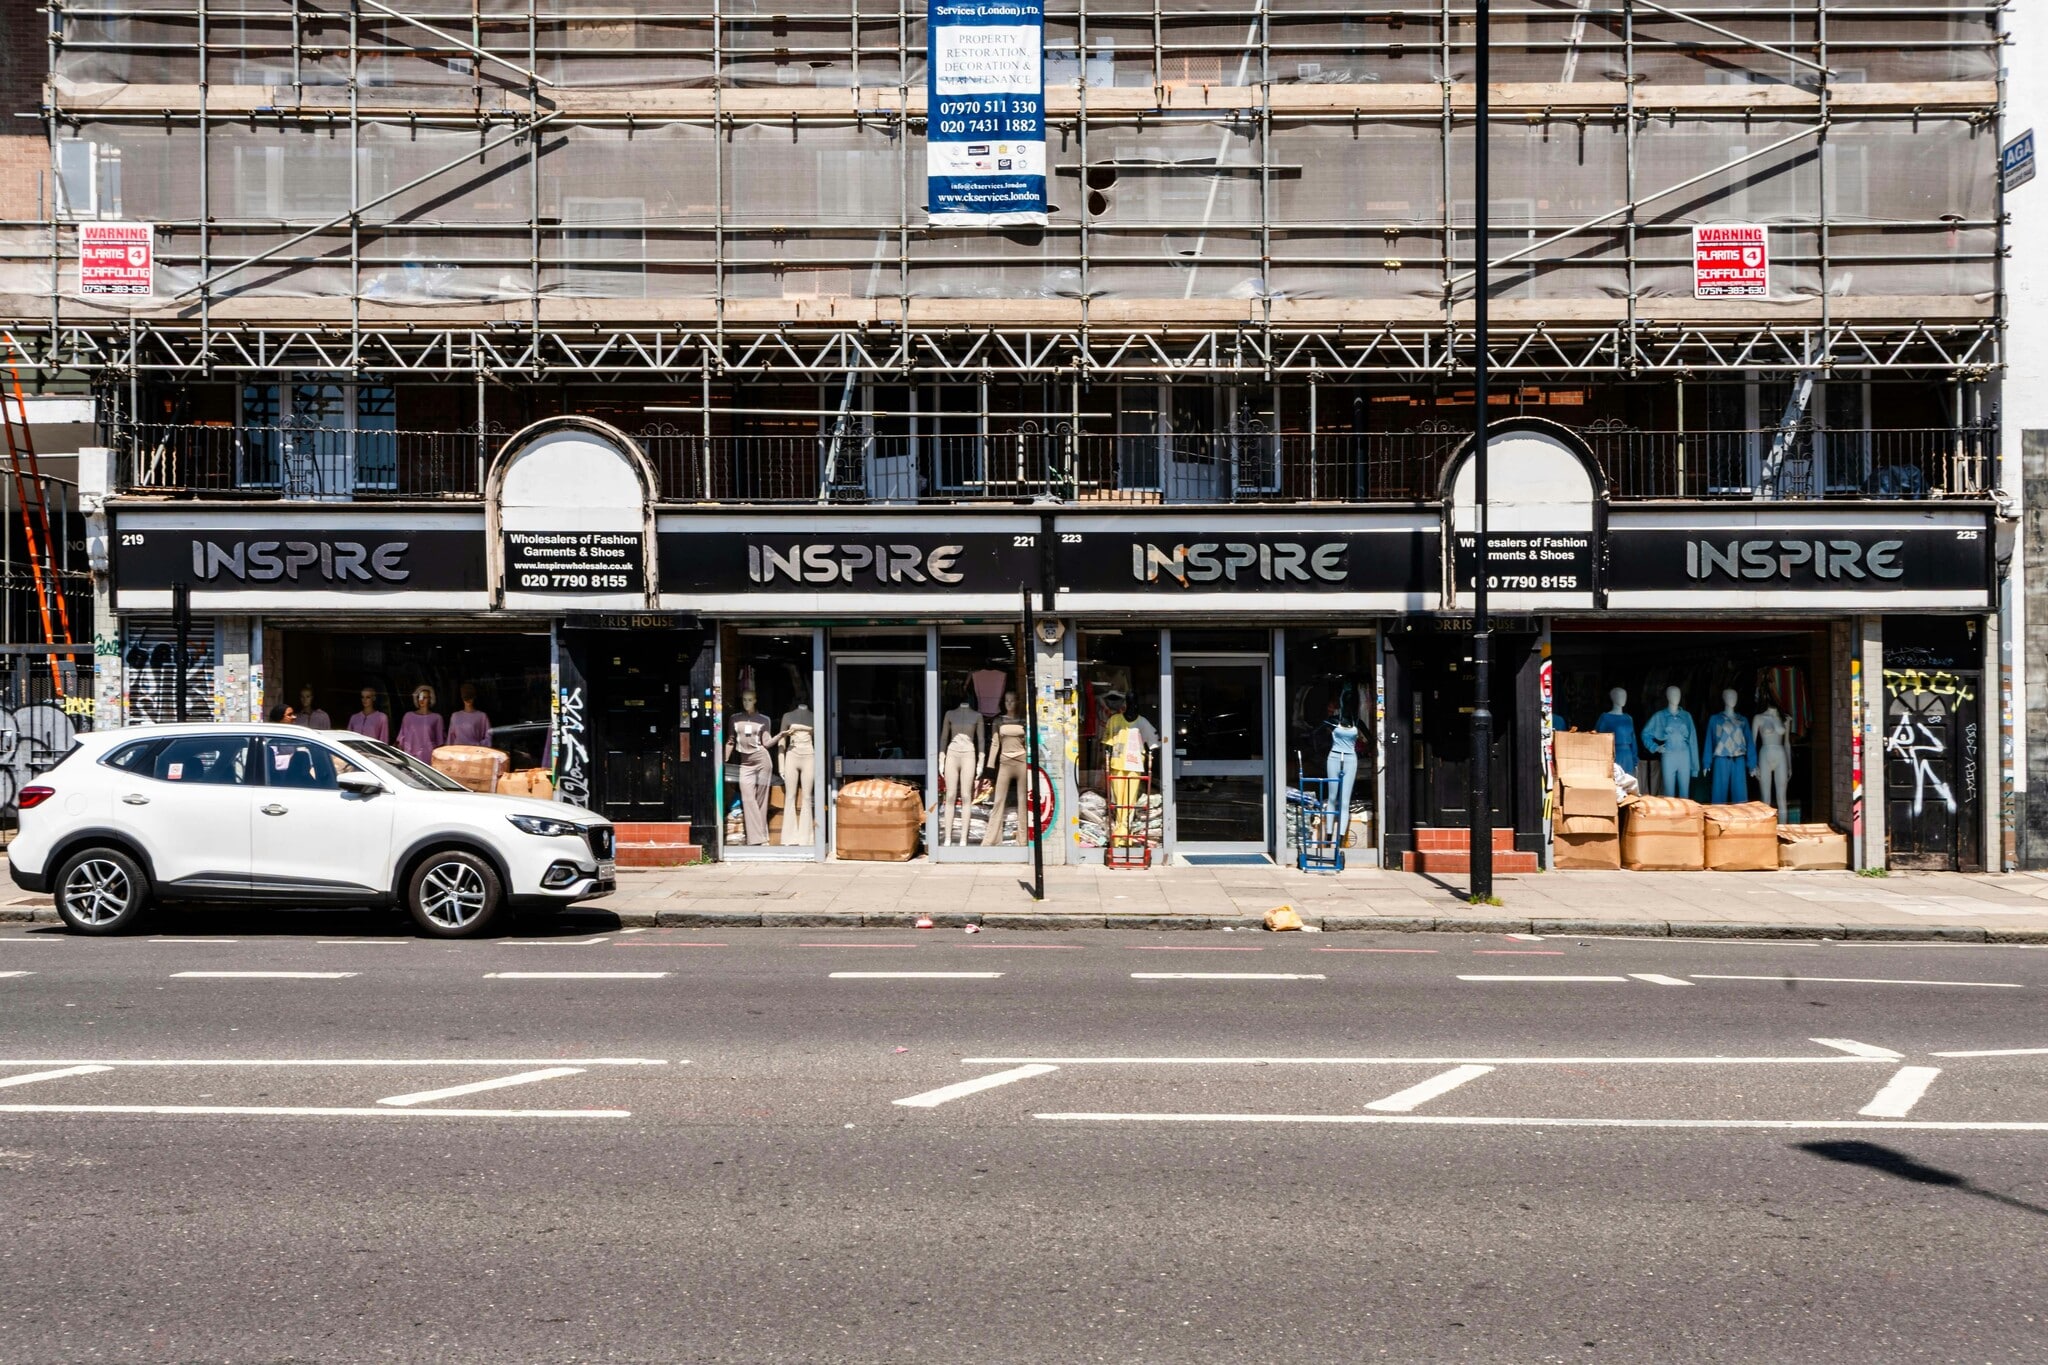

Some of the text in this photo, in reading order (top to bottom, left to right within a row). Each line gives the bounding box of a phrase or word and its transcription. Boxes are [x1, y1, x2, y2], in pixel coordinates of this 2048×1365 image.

[937, 6, 975, 15] Services
[977, 6, 1020, 16] (London)
[959, 34, 1017, 44] PROPERTY
[946, 47, 1030, 58] RESTORATION,
[944, 60, 1031, 72] DECORATION &
[943, 74, 1032, 86] MAINTENANCE
[940, 100, 1037, 115] 07970 511 330
[940, 119, 1037, 133] 020 7431 1882
[2006, 138, 2032, 168] AGA
[950, 182, 1028, 190] info@ckservices.london
[937, 191, 1041, 203] www.ckservices.london
[84, 227, 149, 240] WARNING
[1698, 228, 1763, 241] WARNING
[83, 248, 143, 260] ALARMS 4
[1697, 249, 1758, 261] ALARMS 4
[83, 266, 150, 278] SCAFFOLDING
[1697, 268, 1766, 279] SCAFFOLDING
[121, 534, 145, 546] 219
[510, 534, 638, 545] Wholesalers of Fashion
[1013, 536, 1035, 547] 221
[1061, 534, 1083, 543] 223
[1956, 531, 1978, 540] 225
[1460, 537, 1588, 548] Whesalers of Fashion
[523, 546, 625, 557] Garments & Shoes
[1473, 550, 1575, 560] rments & Shoes
[192, 540, 410, 580] INSPIRE
[748, 544, 964, 583] INSPIRE
[1132, 543, 1349, 582] INSPIRE
[1686, 540, 1904, 579] INSPIRE
[514, 562, 634, 571] www.inspirewholesale.co.uk
[521, 574, 628, 587] 020 7790 8155
[1501, 576, 1537, 588] 7790
[1541, 576, 1577, 588] 8155
[631, 615, 674, 627] HOUSE
[1486, 617, 1516, 629] OUSE
